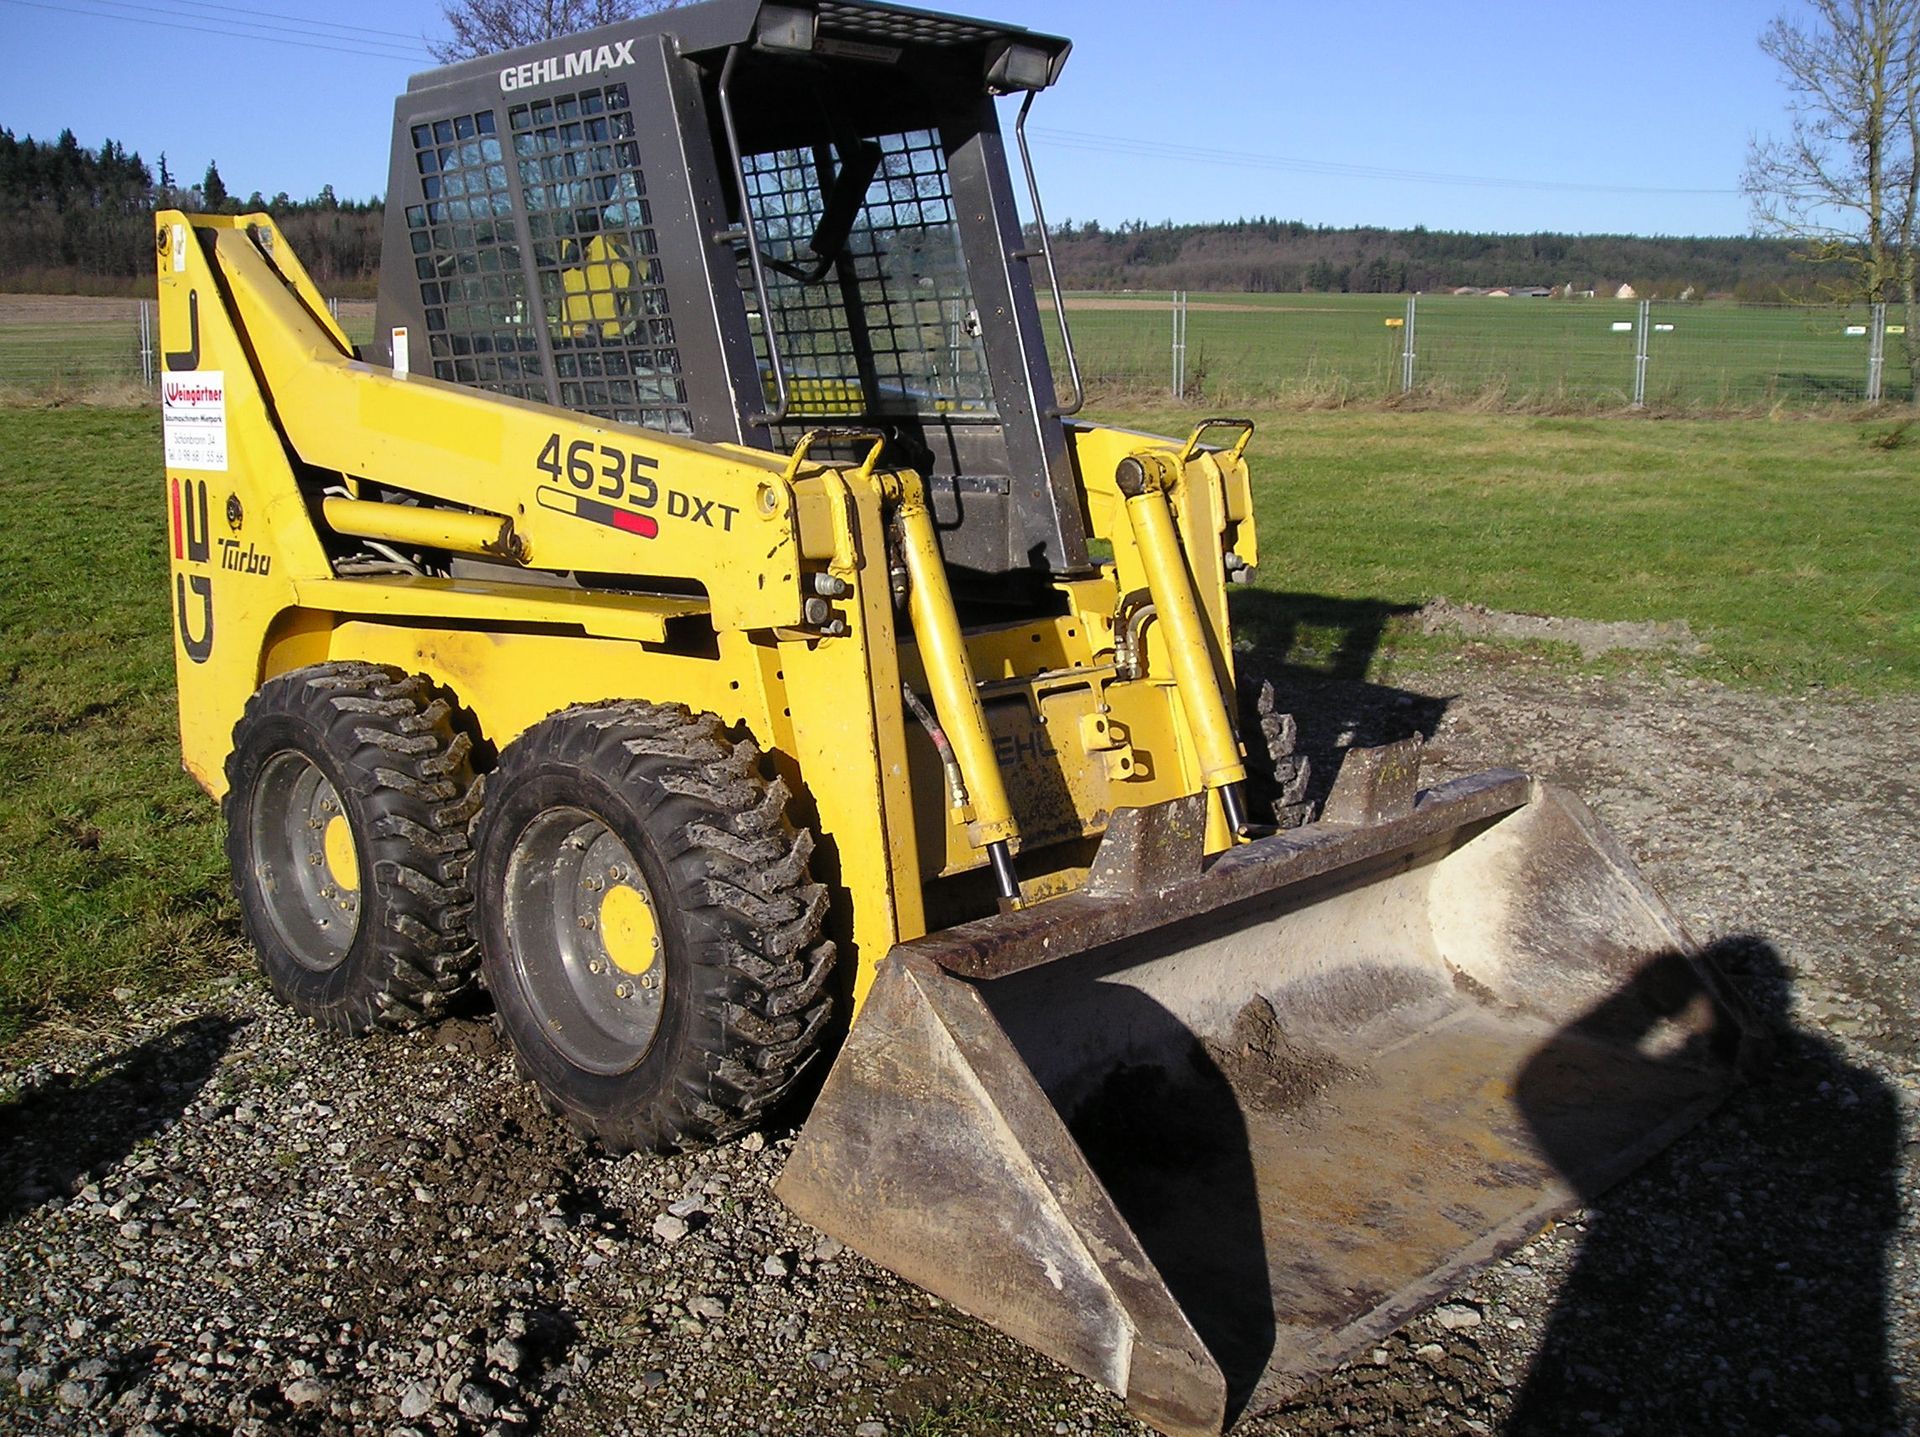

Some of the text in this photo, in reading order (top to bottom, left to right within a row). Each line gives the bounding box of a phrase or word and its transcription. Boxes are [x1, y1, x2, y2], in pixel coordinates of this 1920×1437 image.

[500, 39, 636, 92] GEHLMAX
[165, 382, 222, 407] Weingärtner
[537, 433, 740, 532] 4635 DXT
[217, 538, 271, 576] Turbo
[992, 731, 1057, 766] EHL
